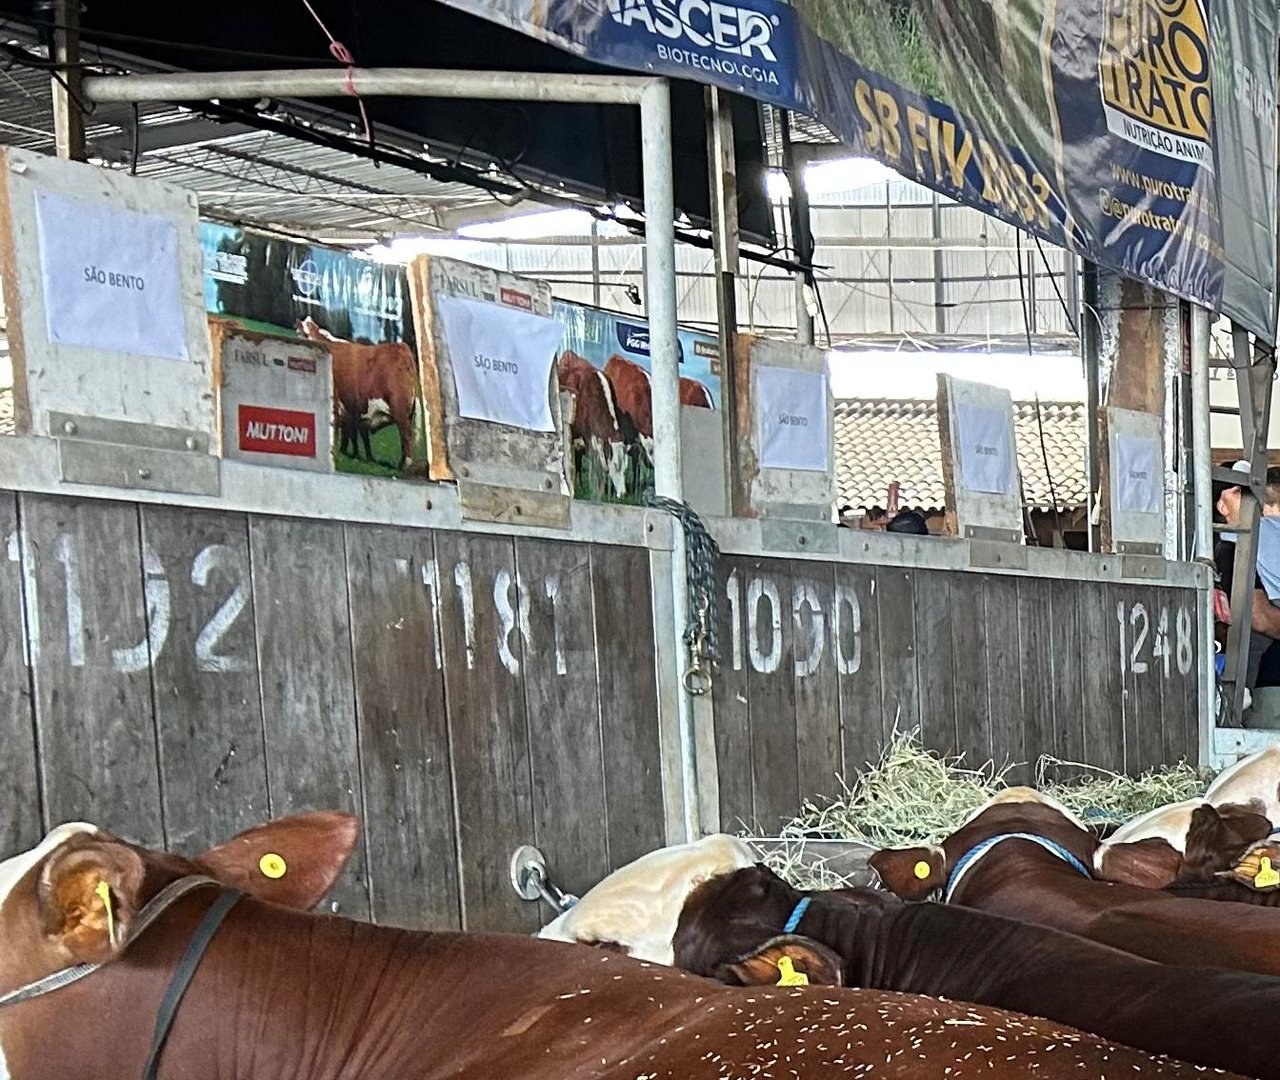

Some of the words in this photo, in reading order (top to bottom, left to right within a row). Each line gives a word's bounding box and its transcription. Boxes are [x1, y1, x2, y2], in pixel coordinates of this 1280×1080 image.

[657, 44, 779, 86] BIOTECNOLOGIA
[906, 106, 974, 190] FIV
[1123, 119, 1172, 154] NUTRIÇÃO
[84, 266, 106, 286] SÃO
[109, 271, 145, 291] BENTO
[474, 354, 491, 371] SÃO
[492, 360, 518, 375] BENTO
[246, 420, 309, 444] MUTTONI
[1117, 601, 1193, 679] 1248
